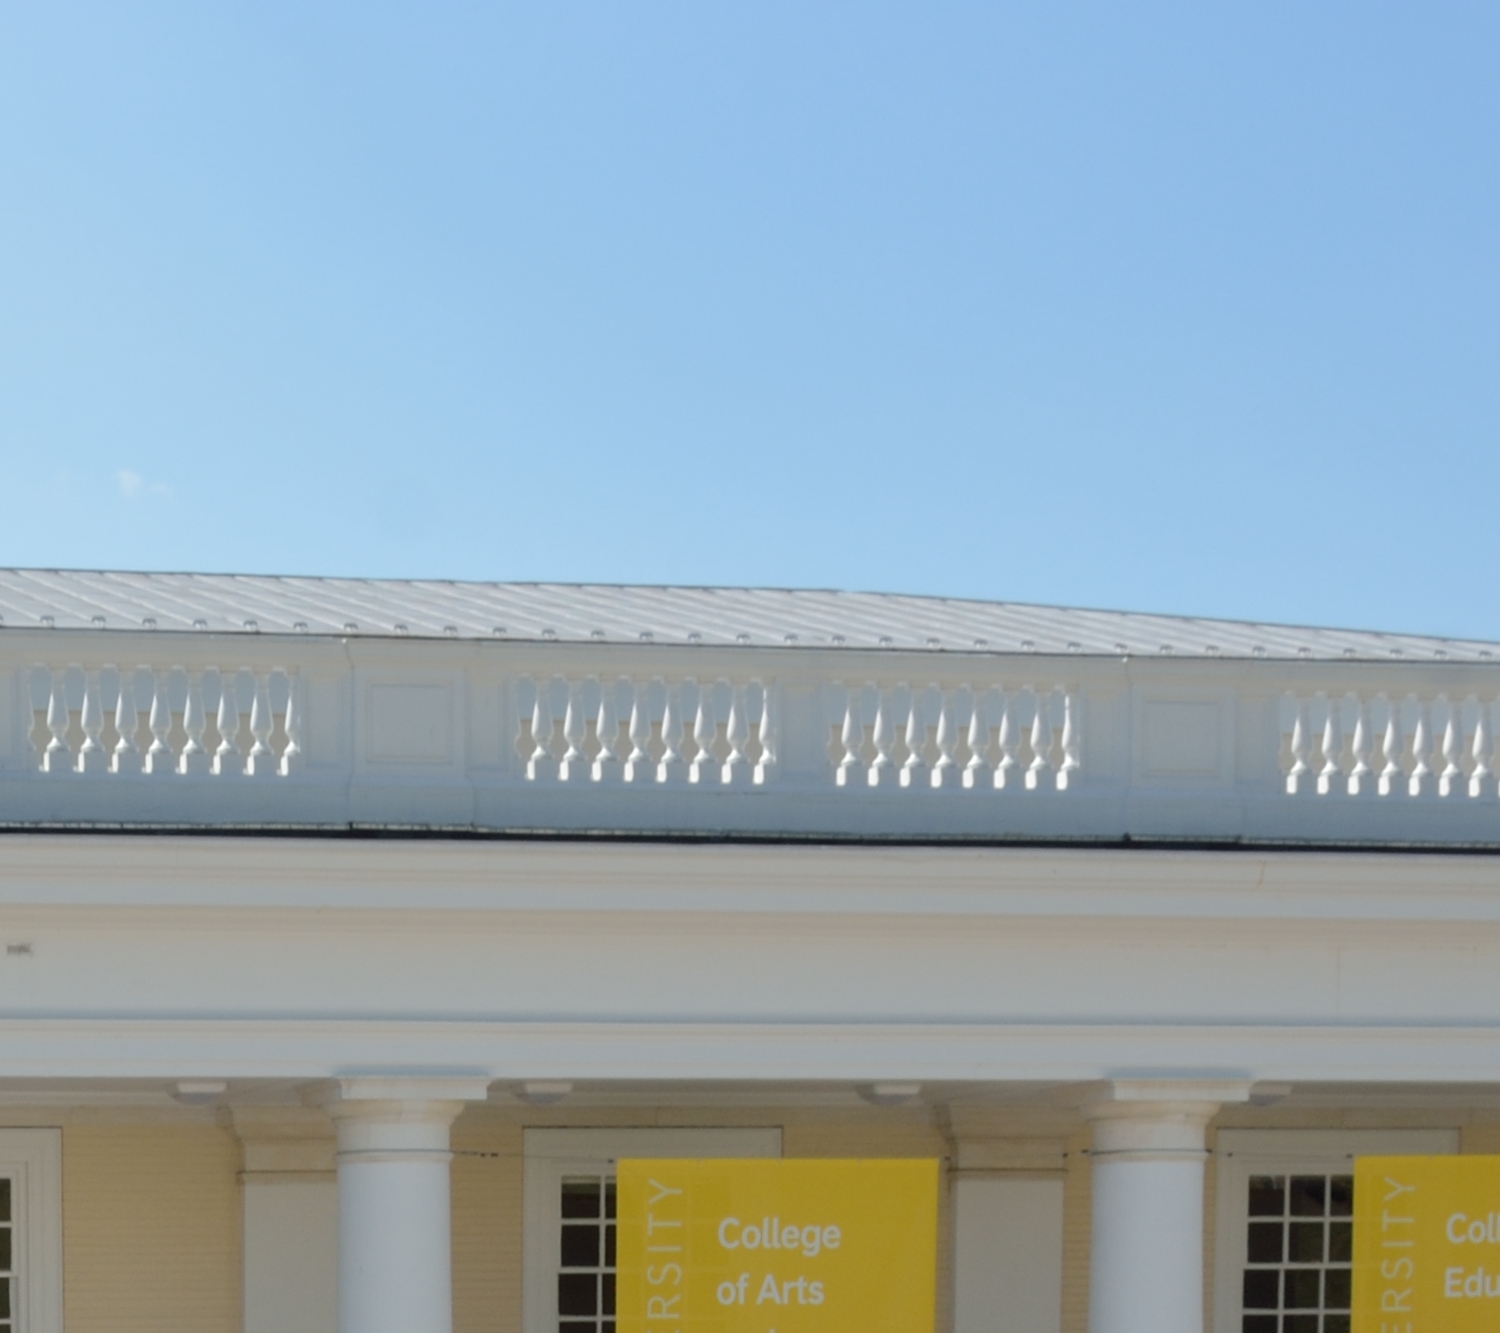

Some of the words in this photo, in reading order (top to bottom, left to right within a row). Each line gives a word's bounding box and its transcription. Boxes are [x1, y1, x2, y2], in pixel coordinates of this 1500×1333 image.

[717, 1216, 841, 1253] College
[716, 1274, 749, 1305] of
[757, 1274, 824, 1306] Arts
